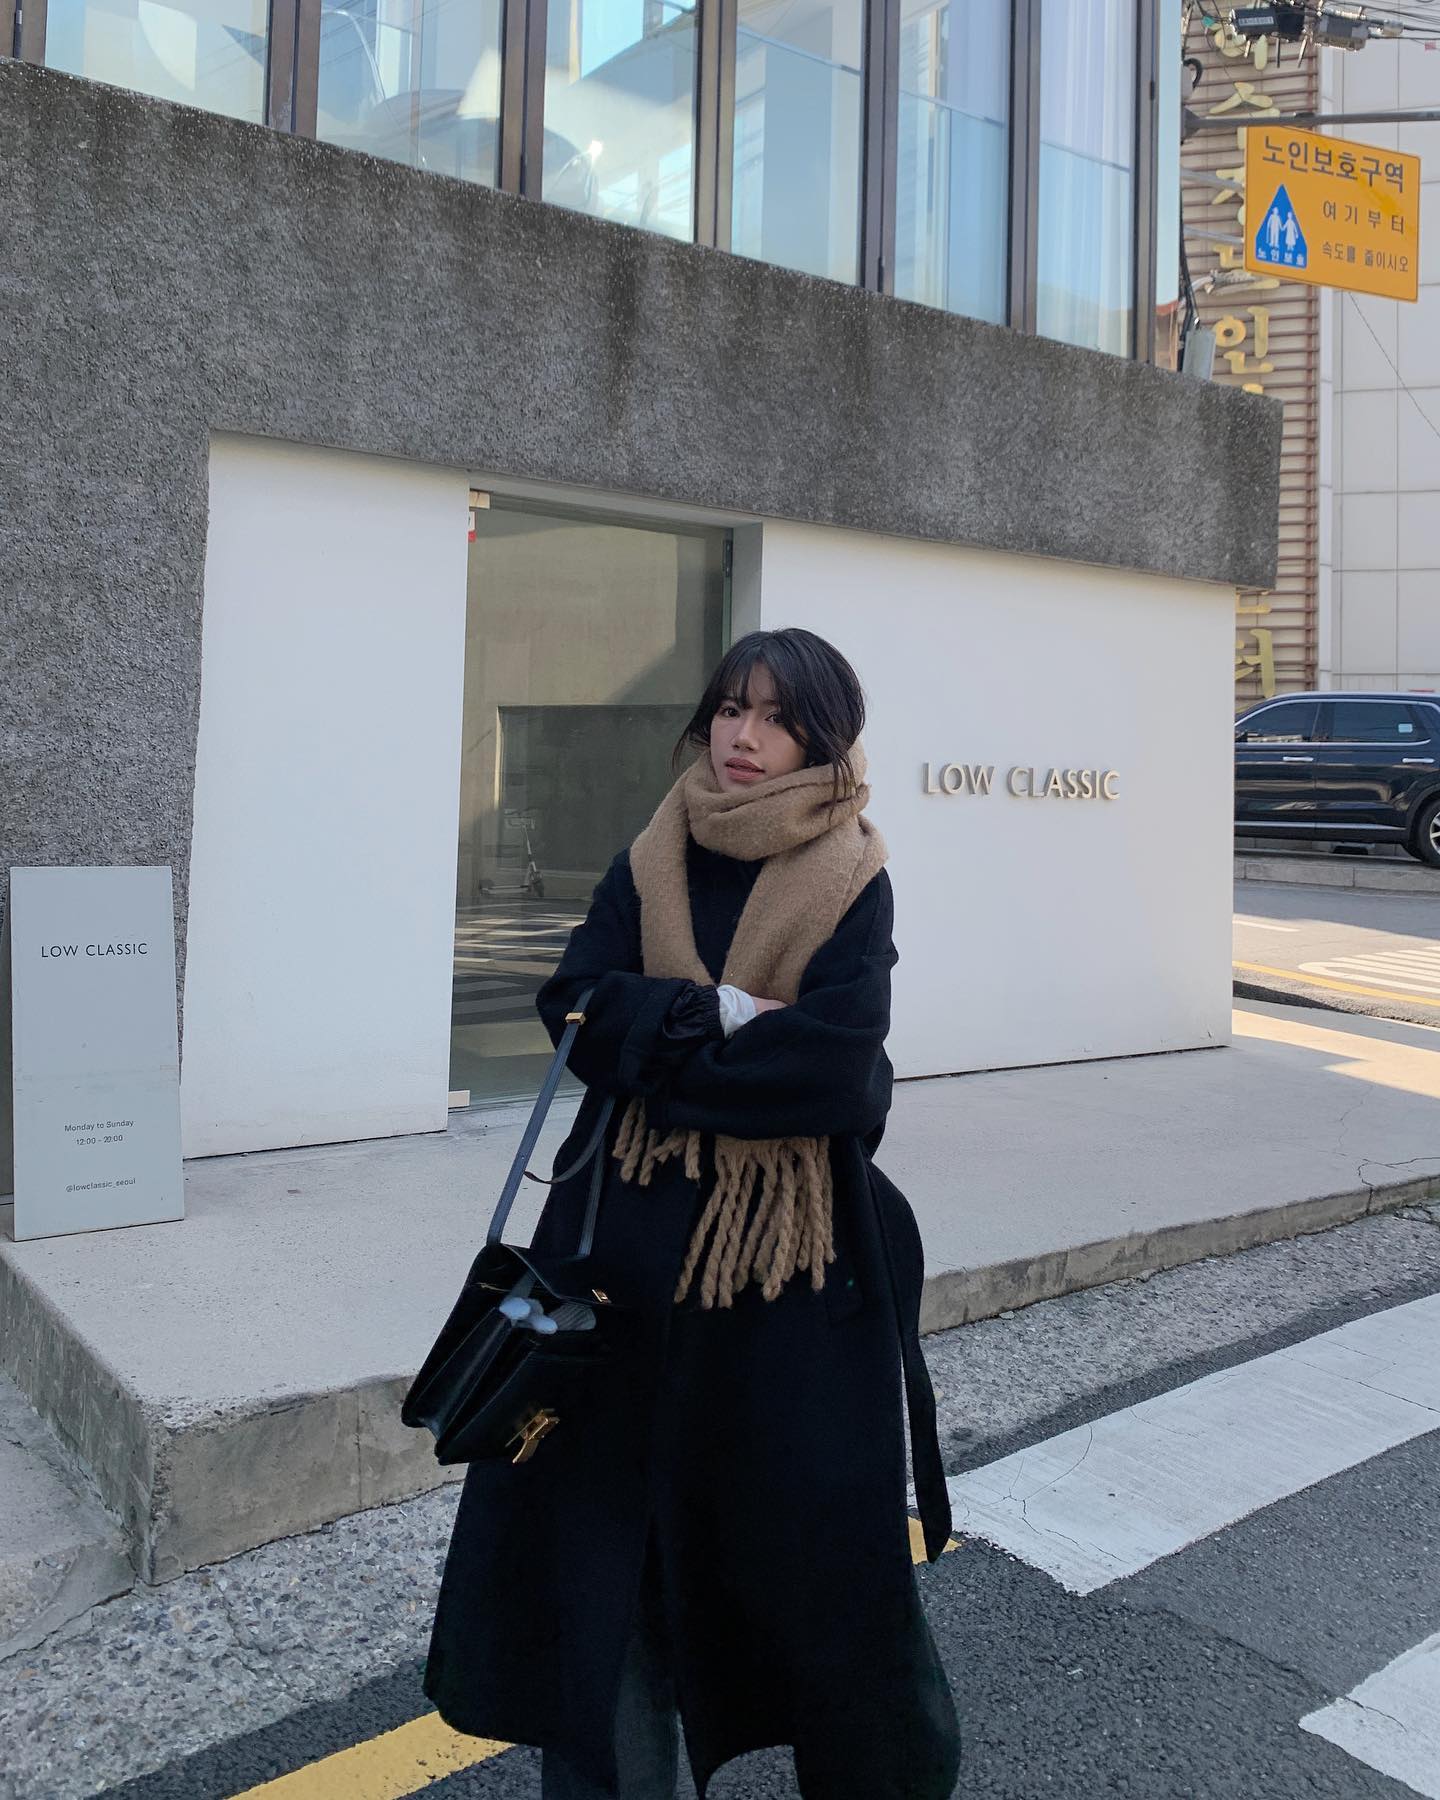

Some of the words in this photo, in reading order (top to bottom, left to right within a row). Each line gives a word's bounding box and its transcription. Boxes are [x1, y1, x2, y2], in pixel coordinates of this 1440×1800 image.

[1262, 135, 1404, 194] 노인보호구역
[922, 761, 995, 796] LOW
[1007, 766, 1121, 801] CLASSIC
[41, 945, 79, 958] LOW
[85, 942, 148, 956] CLASSIC
[64, 1123, 95, 1132] Monday
[106, 1120, 134, 1128] Sunday
[65, 1177, 136, 1193] @lowclassic_seoul
